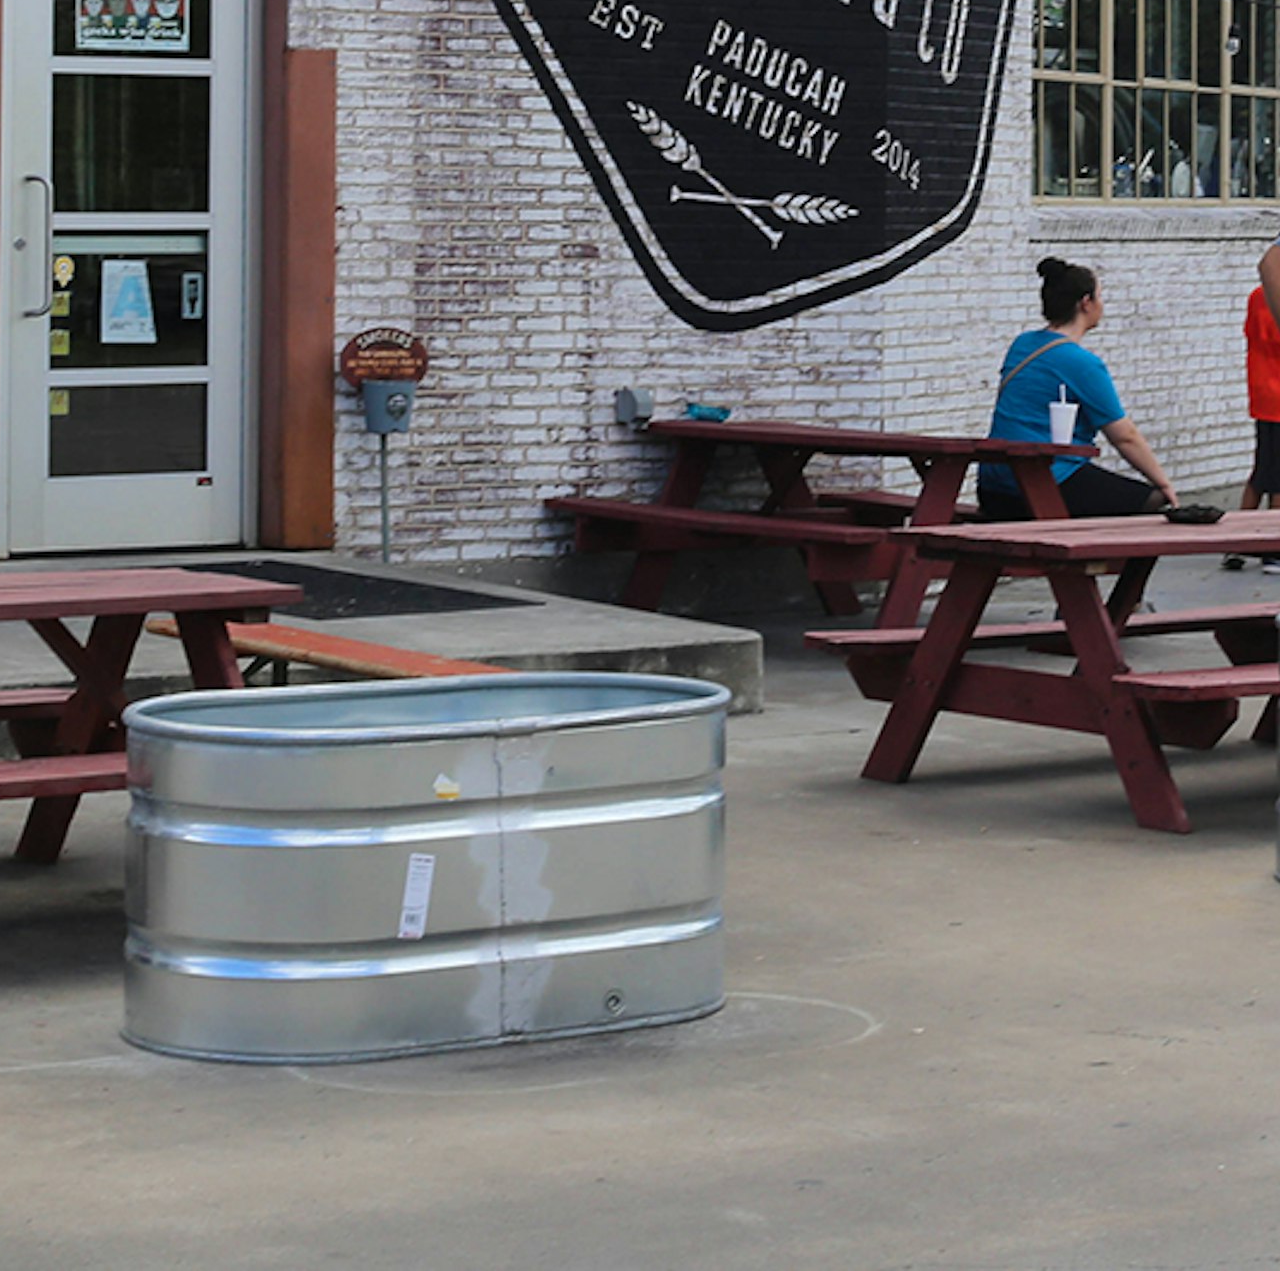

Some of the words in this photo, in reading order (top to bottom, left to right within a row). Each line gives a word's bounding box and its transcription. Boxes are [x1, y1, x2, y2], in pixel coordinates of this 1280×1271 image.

[684, 64, 841, 166] KENTUCKY
[706, 19, 847, 117] PADUCAH
[871, 129, 922, 191] 2014
